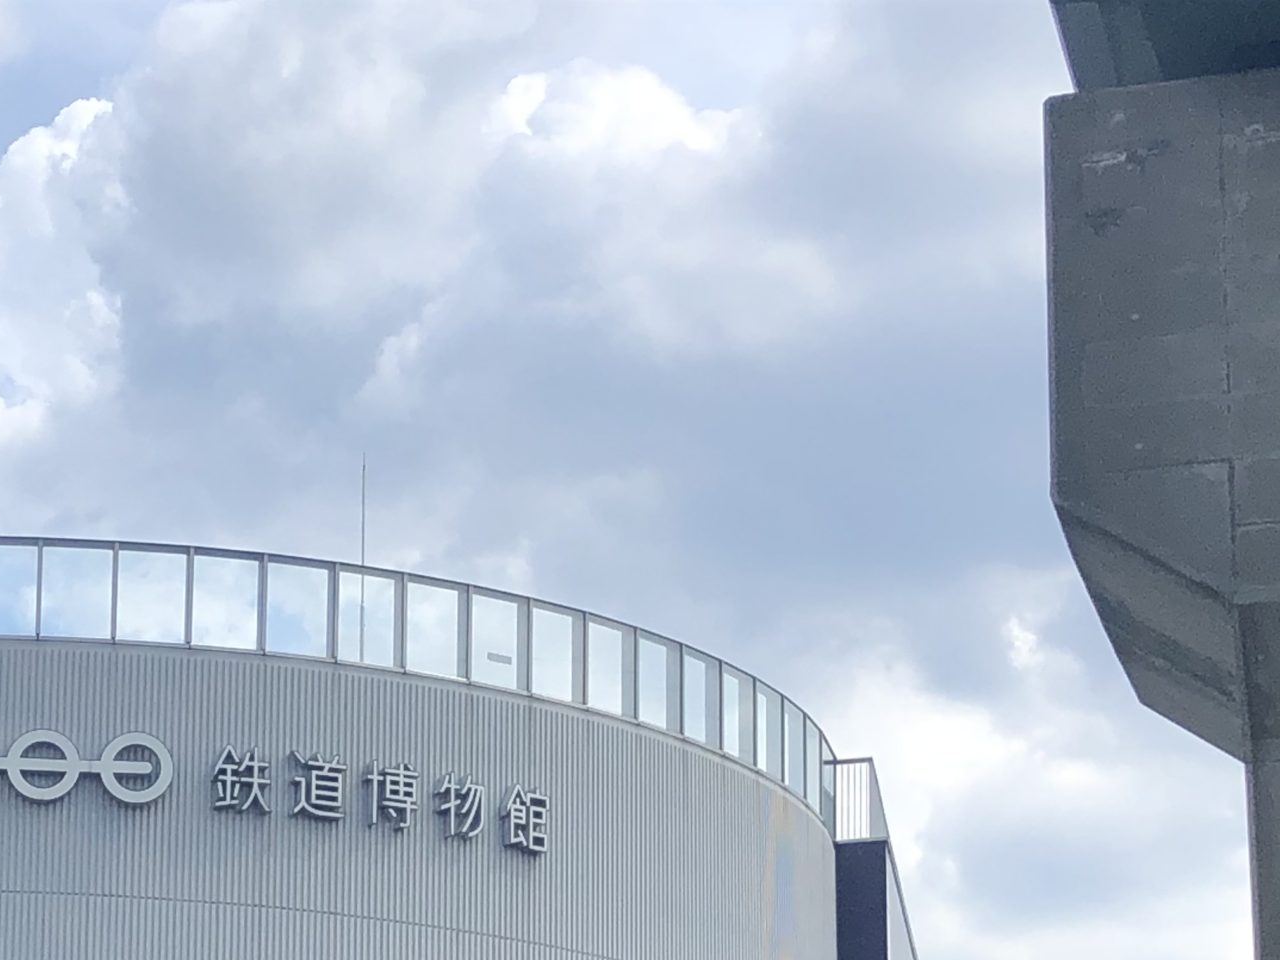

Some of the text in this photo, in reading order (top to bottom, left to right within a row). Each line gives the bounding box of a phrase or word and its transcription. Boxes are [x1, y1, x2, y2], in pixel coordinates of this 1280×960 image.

[213, 744, 550, 853] 鉄道博物館
